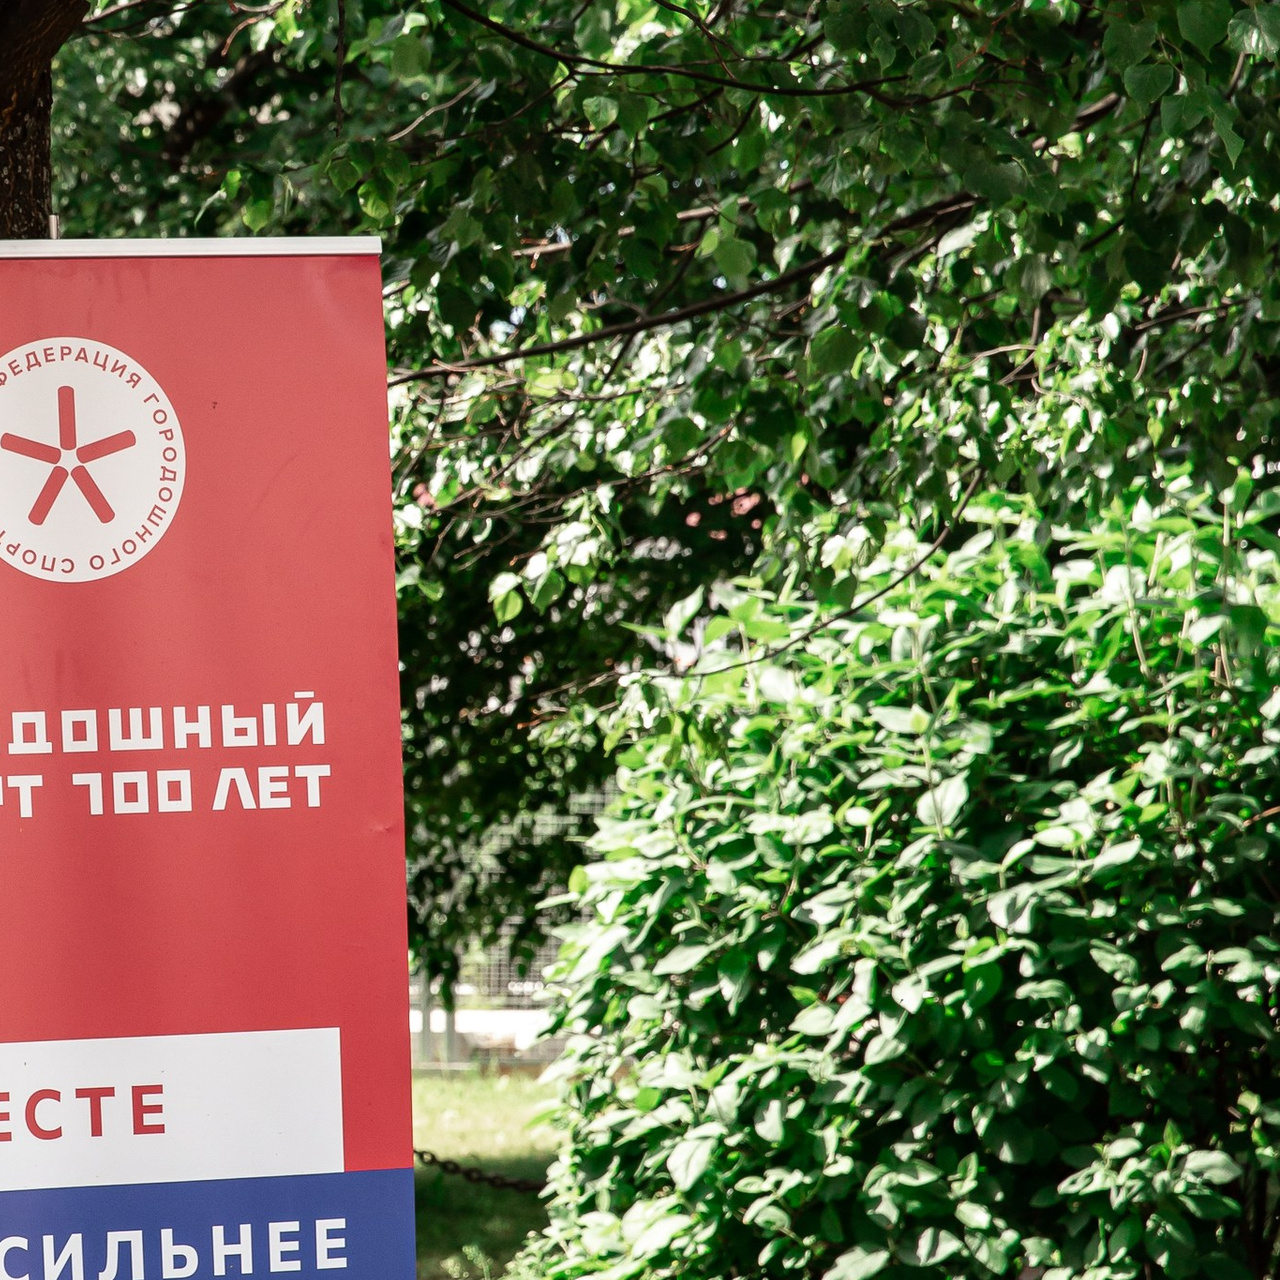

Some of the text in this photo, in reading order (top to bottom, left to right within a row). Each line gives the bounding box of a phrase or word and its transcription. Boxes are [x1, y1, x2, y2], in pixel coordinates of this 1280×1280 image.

[89, 393, 177, 571] ГОРОДОШНОГО
[72, 769, 192, 816] 100
[212, 764, 331, 810] ЛЕТ
